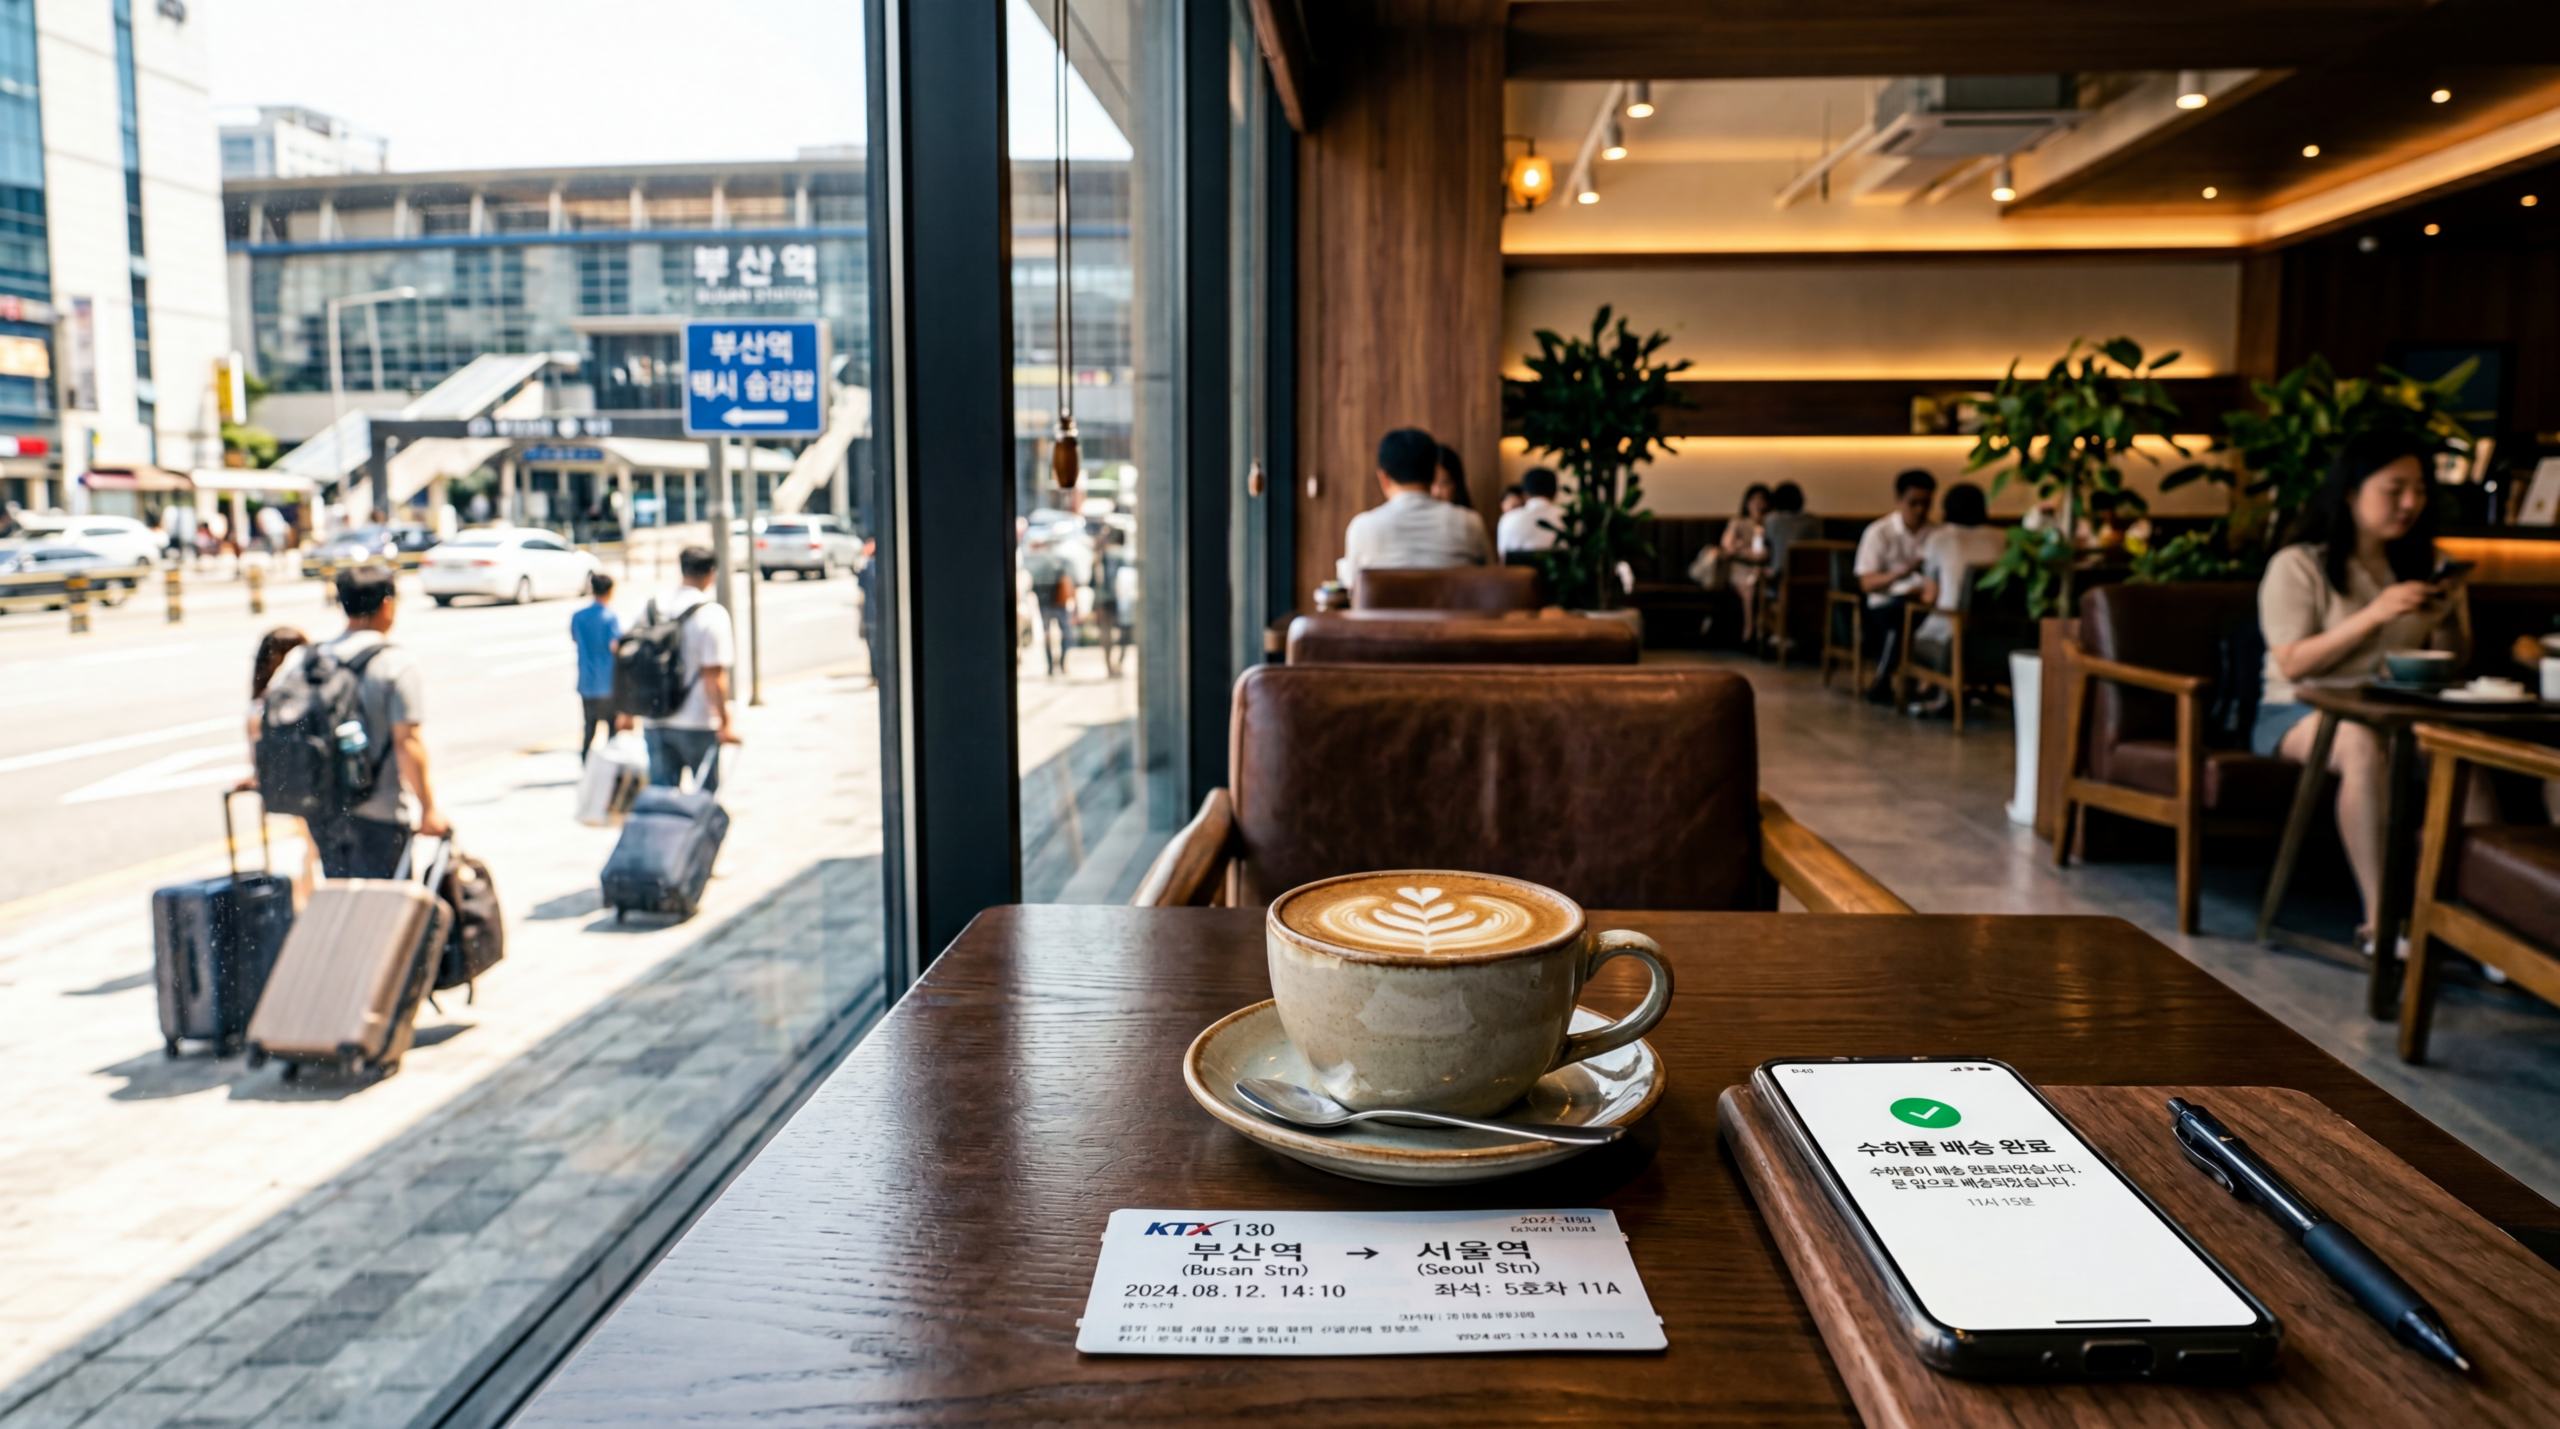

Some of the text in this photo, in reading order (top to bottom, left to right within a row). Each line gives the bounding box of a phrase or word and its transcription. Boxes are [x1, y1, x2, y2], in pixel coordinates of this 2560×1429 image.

[694, 244, 817, 288] 부산역
[709, 330, 794, 365] 부산역
[1857, 1139, 2056, 1157] 수하물 배송 완료
[1144, 1220, 1275, 1236] KTX 130
[1188, 1243, 1302, 1262] 부산역
[1417, 1241, 1531, 1260] 서울역
[1182, 1264, 1308, 1277] (Busan Stn)
[1417, 1261, 1540, 1276] (Seoul Stn)
[1124, 1284, 1346, 1298] 2024.08.12. 14:10
[1435, 1281, 1621, 1297] 좌석: 5호차 11A
